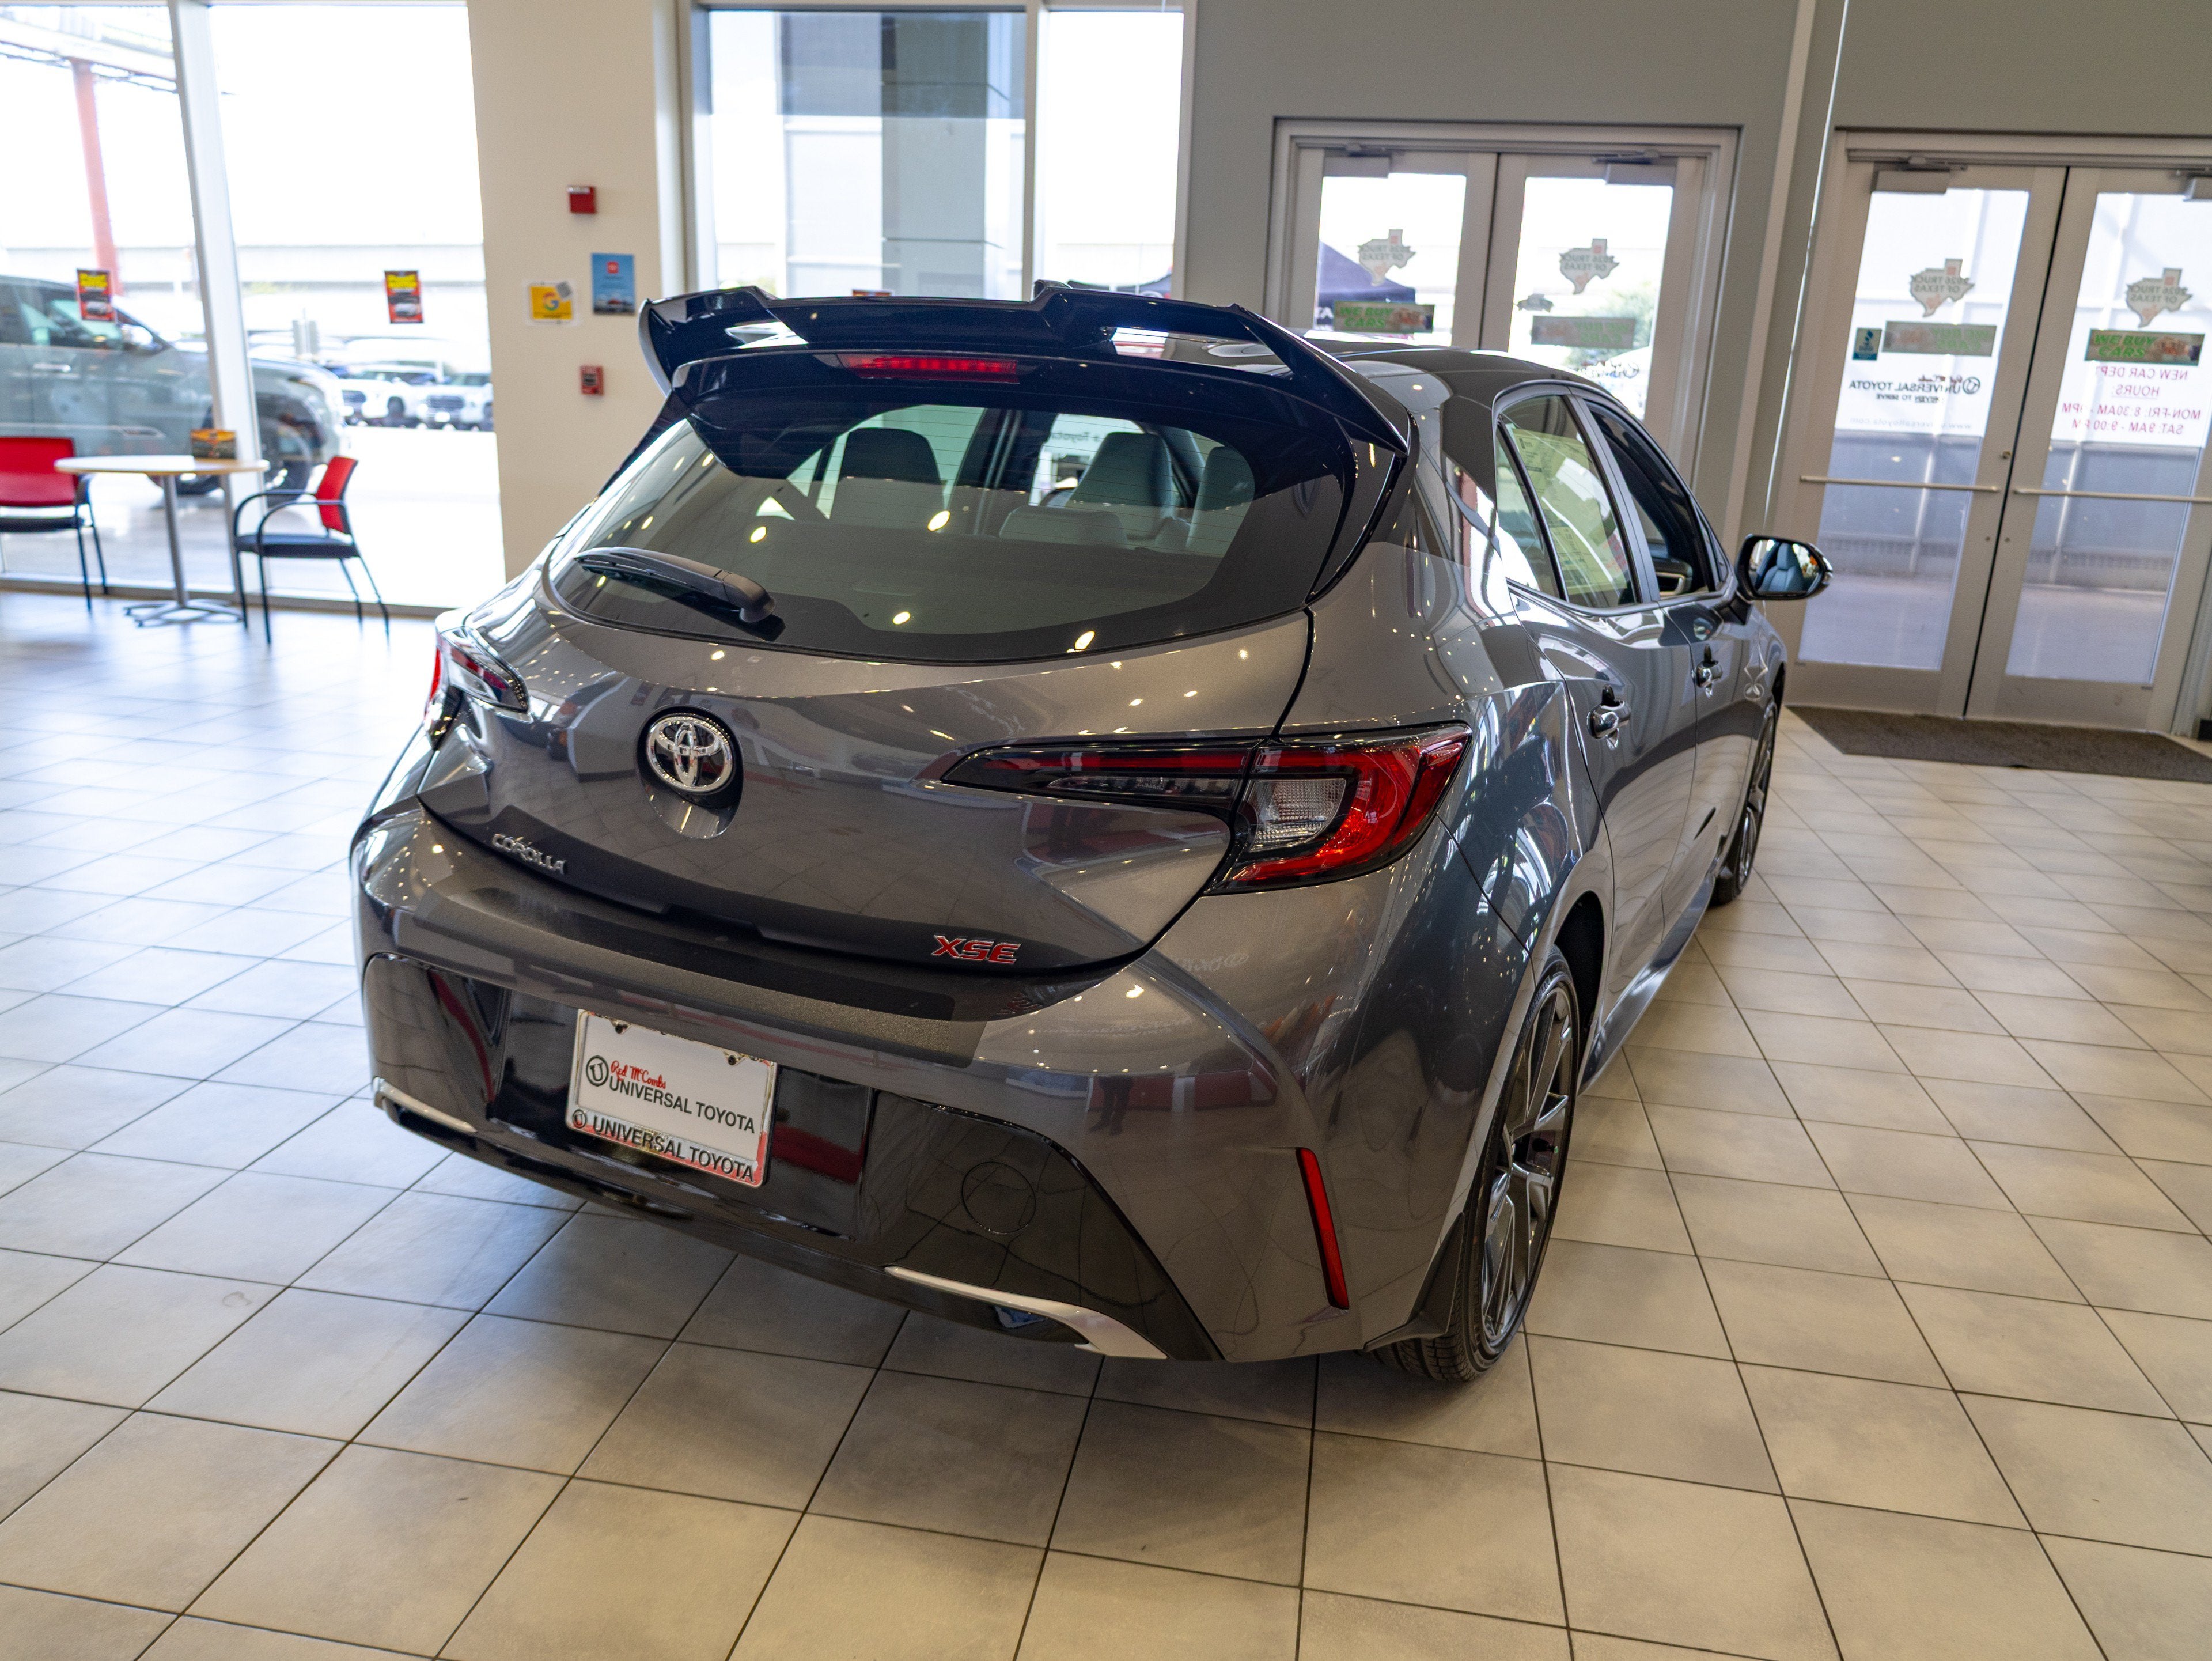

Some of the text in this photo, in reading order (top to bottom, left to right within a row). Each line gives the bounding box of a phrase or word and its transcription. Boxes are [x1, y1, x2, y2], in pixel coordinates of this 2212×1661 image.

[1340, 307, 1394, 317] WE BUY
[1344, 317, 1385, 329] CARS
[2094, 334, 2157, 346] WE BUY
[2099, 346, 2145, 358] CARS
[493, 834, 566, 874] COROLLA
[931, 934, 1022, 964] XSE
[611, 1060, 628, 1081] Red
[609, 1075, 756, 1133] UNIVERSAL TOYOTA
[593, 1115, 756, 1183] UNIVERSAL TOYOTA
